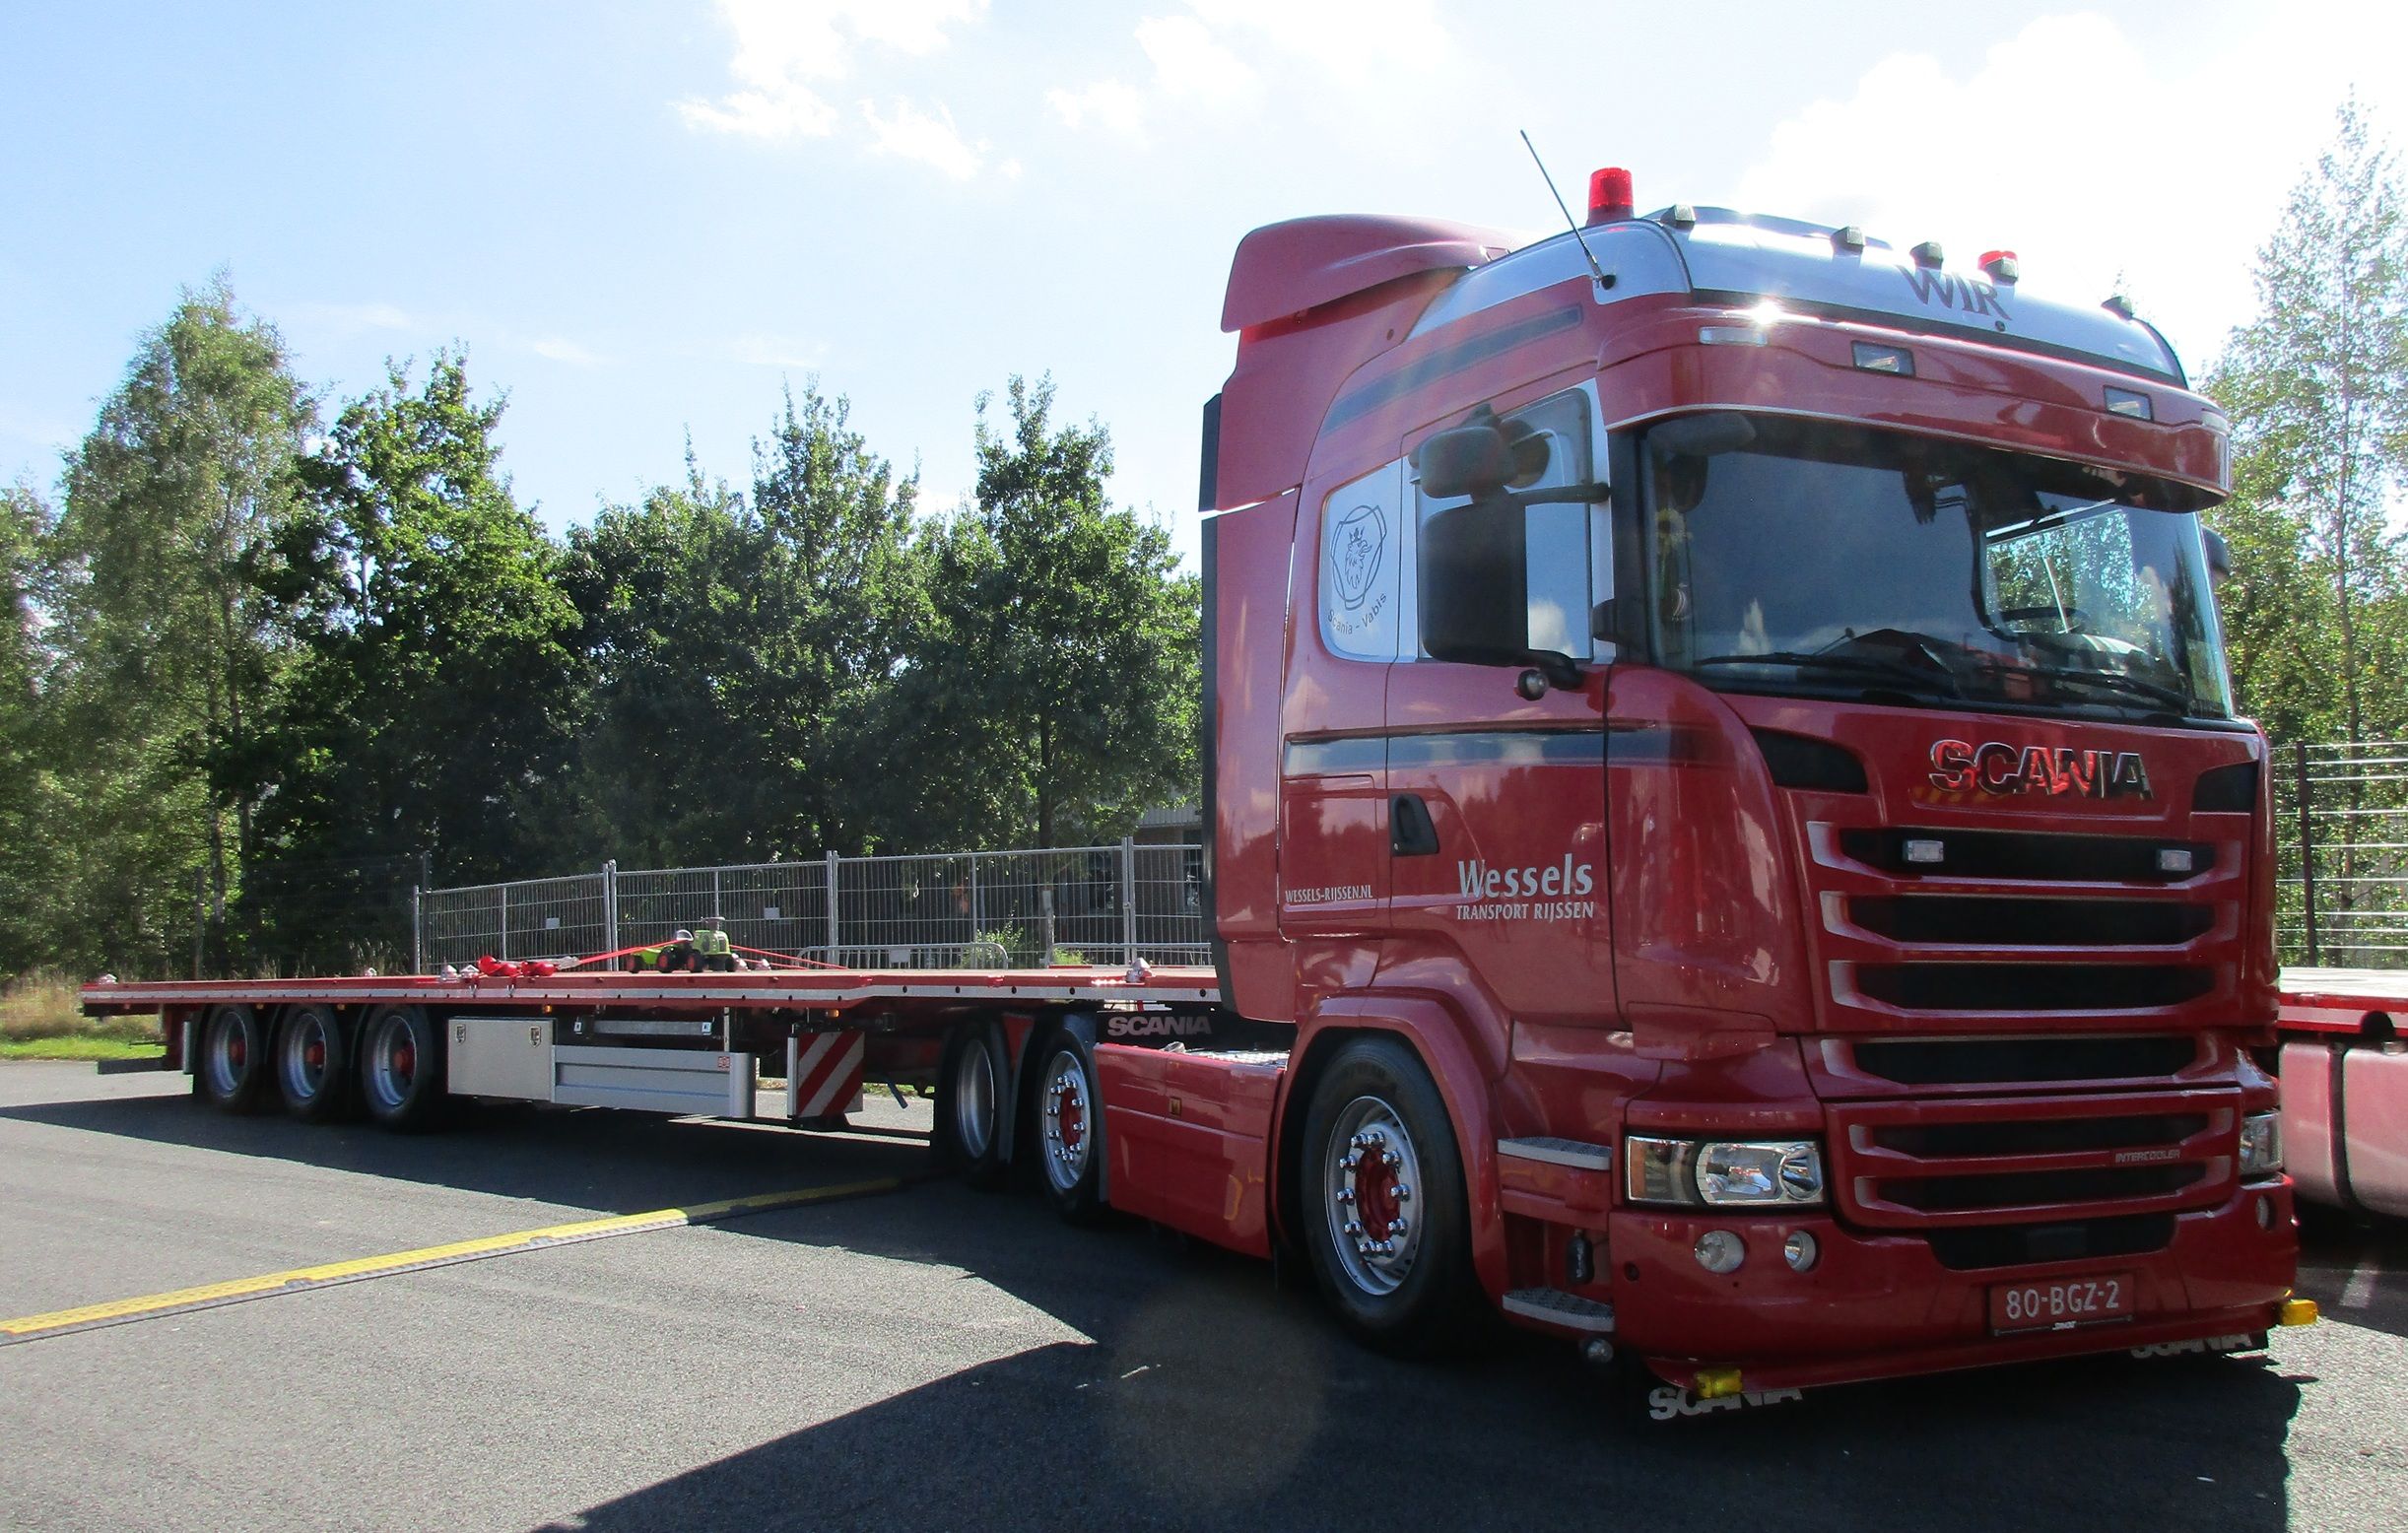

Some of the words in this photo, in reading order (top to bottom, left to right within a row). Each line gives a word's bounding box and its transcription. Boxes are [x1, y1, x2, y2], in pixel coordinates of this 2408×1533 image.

[1895, 264, 2012, 320] WIR
[1327, 608, 1353, 634] Scania
[1362, 593, 1387, 628] Vabis
[1928, 739, 2154, 800] SCANIA
[1285, 885, 1373, 902] WESSELS-RIJSSEN.NL
[1457, 852, 1593, 899] Wessels
[1456, 903, 1529, 920] TRANSPORT
[1533, 900, 1594, 923] RIJSSEN
[1107, 1016, 1212, 1036] SCANIA
[2006, 1280, 2119, 1319] 80-BGZ-2
